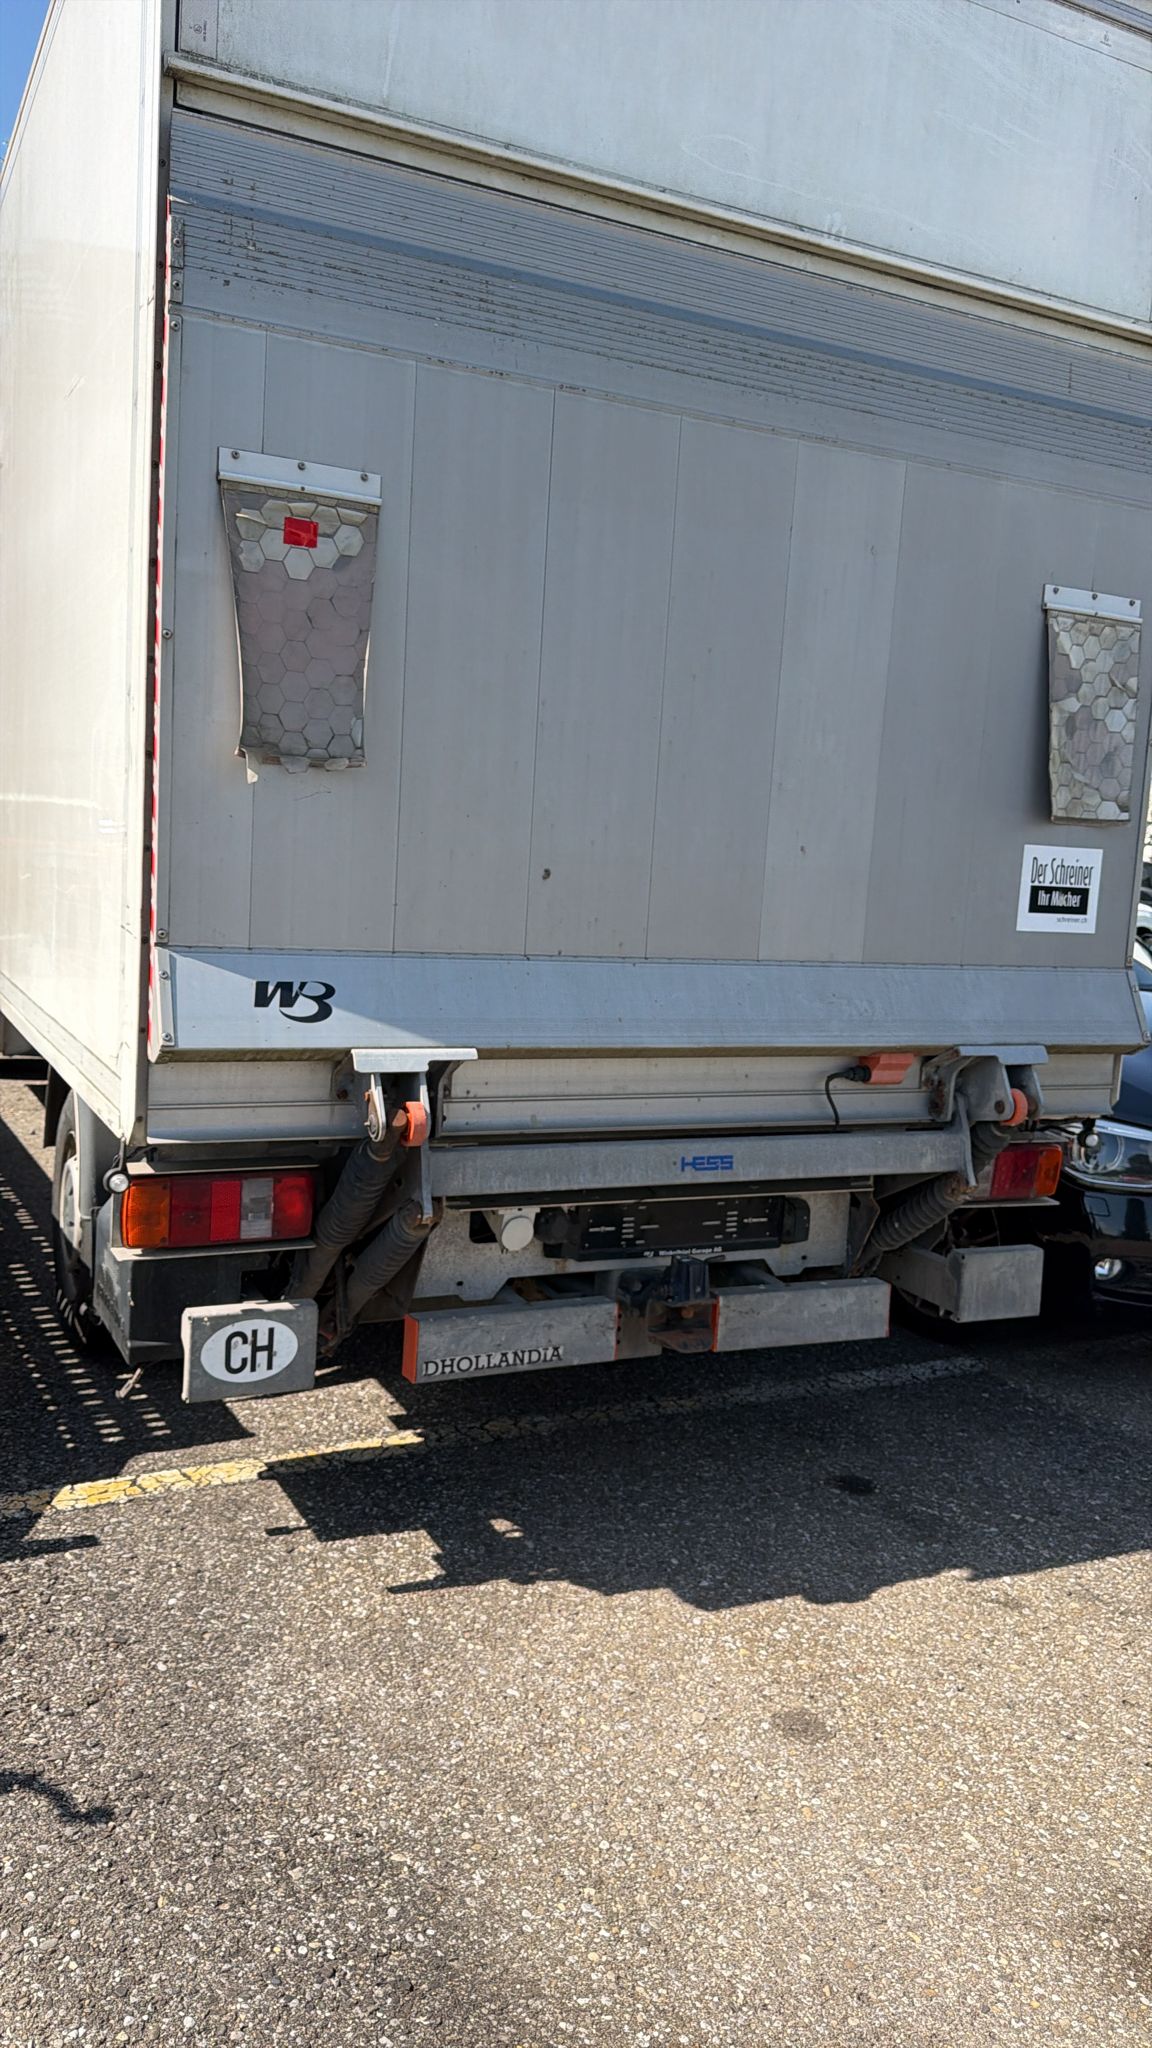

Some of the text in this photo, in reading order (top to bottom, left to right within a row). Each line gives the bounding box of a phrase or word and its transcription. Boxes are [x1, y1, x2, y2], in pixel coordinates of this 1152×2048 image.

[1030, 856, 1094, 886] Der Schreiner
[1037, 890, 1051, 906] Ihr
[681, 1155, 733, 1172] HESS
[224, 1326, 275, 1375] CH
[423, 1346, 562, 1376] DHOLLANDIA
